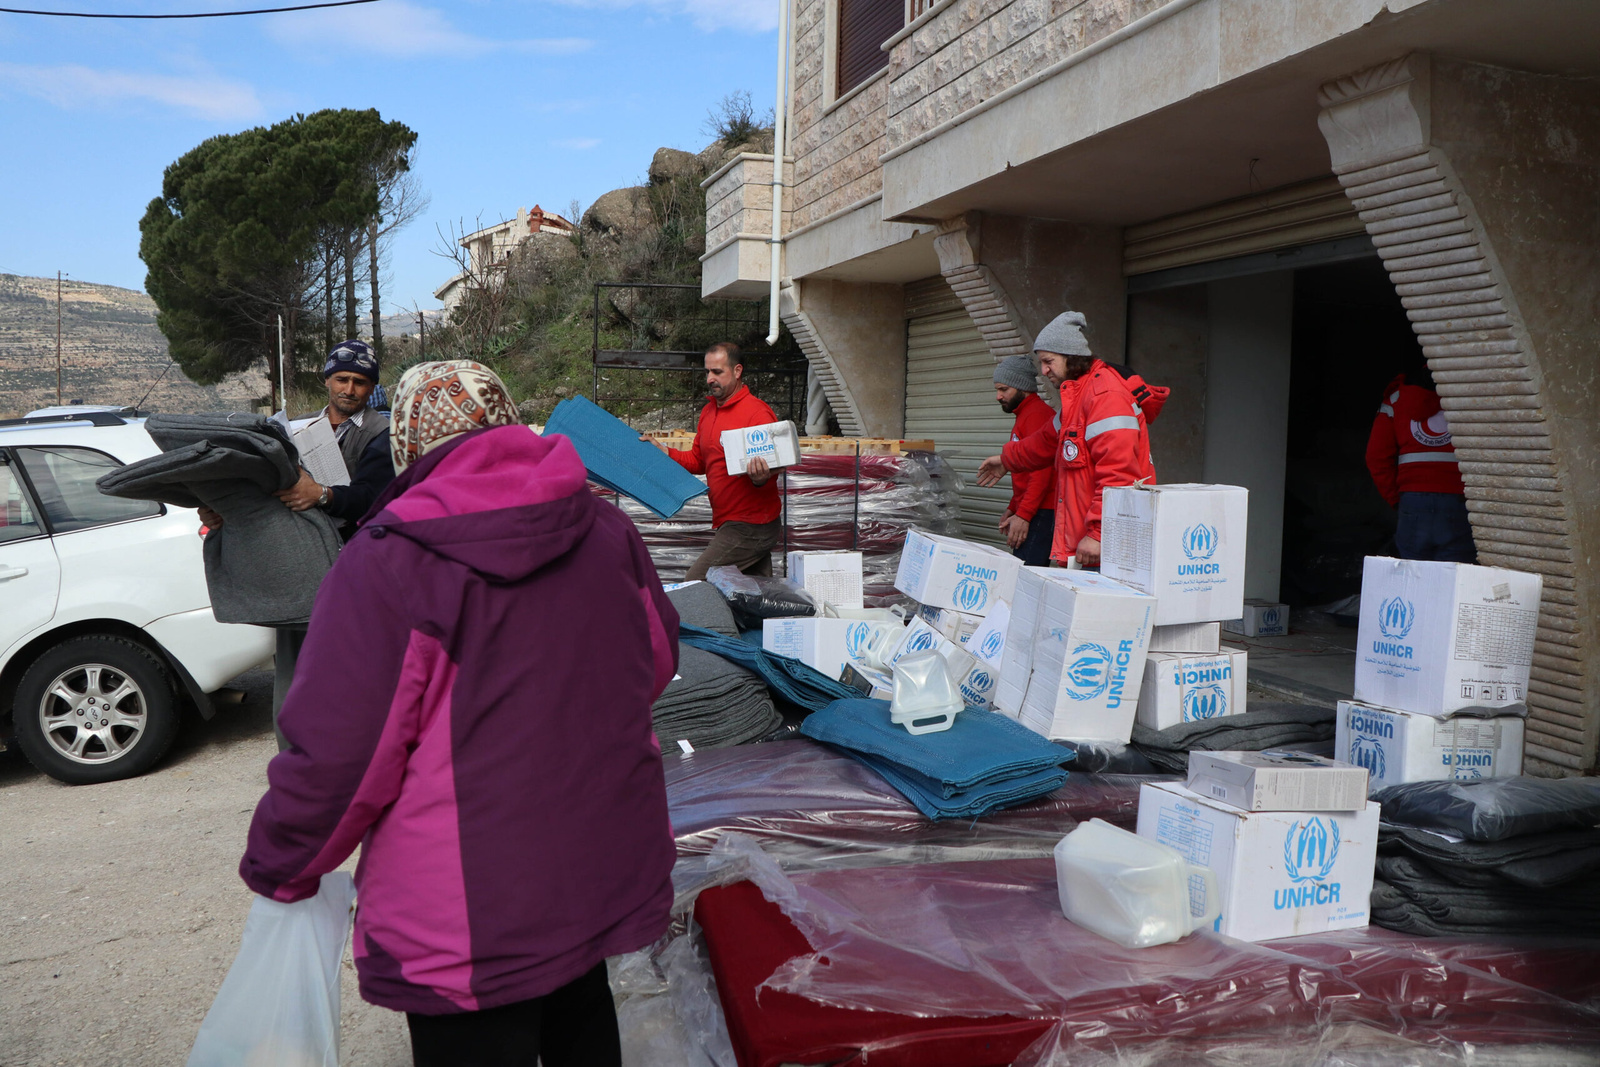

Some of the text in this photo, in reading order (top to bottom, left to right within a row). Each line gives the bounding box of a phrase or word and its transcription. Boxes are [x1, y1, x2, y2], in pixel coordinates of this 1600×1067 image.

[955, 562, 998, 581] UNHCR
[1178, 563, 1220, 576] UNHCR
[920, 604, 940, 623] UNHC
[1258, 626, 1283, 634] UNHCR
[1373, 640, 1413, 660] UNHCR
[1106, 640, 1133, 709] UNHCR
[1174, 666, 1231, 686] UNHCR
[1442, 754, 1492, 767] UNHCR
[1174, 803, 1193, 815] Option
[1273, 883, 1341, 910] UNHCR
